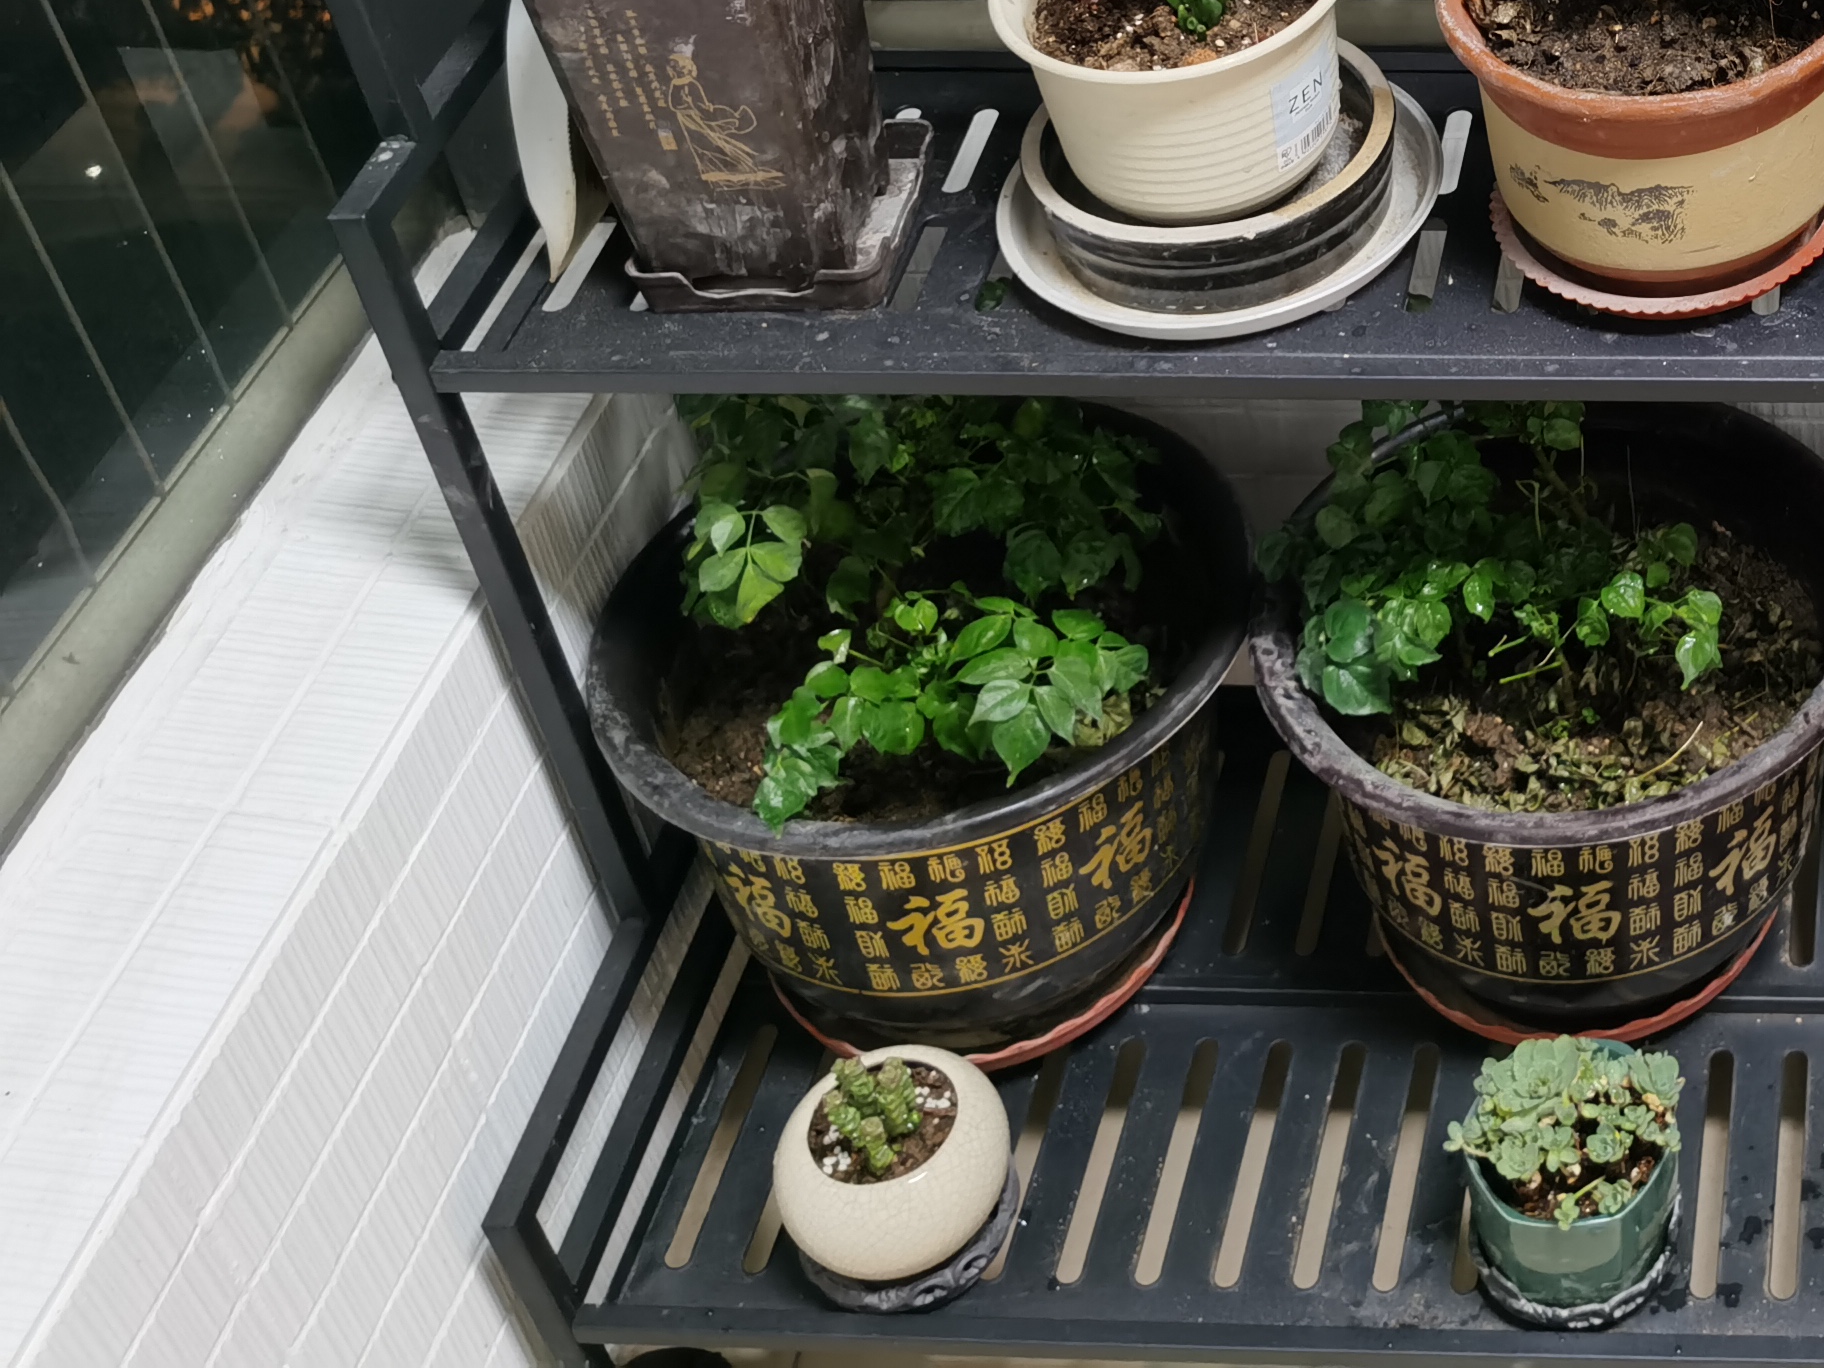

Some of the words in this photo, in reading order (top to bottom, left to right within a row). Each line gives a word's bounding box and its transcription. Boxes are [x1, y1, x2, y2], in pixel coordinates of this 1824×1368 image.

[1288, 69, 1323, 115] ZEN
[1078, 801, 1154, 889] 福
[1371, 836, 1442, 916] 福
[1708, 805, 1777, 896] 福
[722, 861, 792, 938] 福
[886, 888, 985, 956] 福
[1526, 880, 1622, 945] 福
